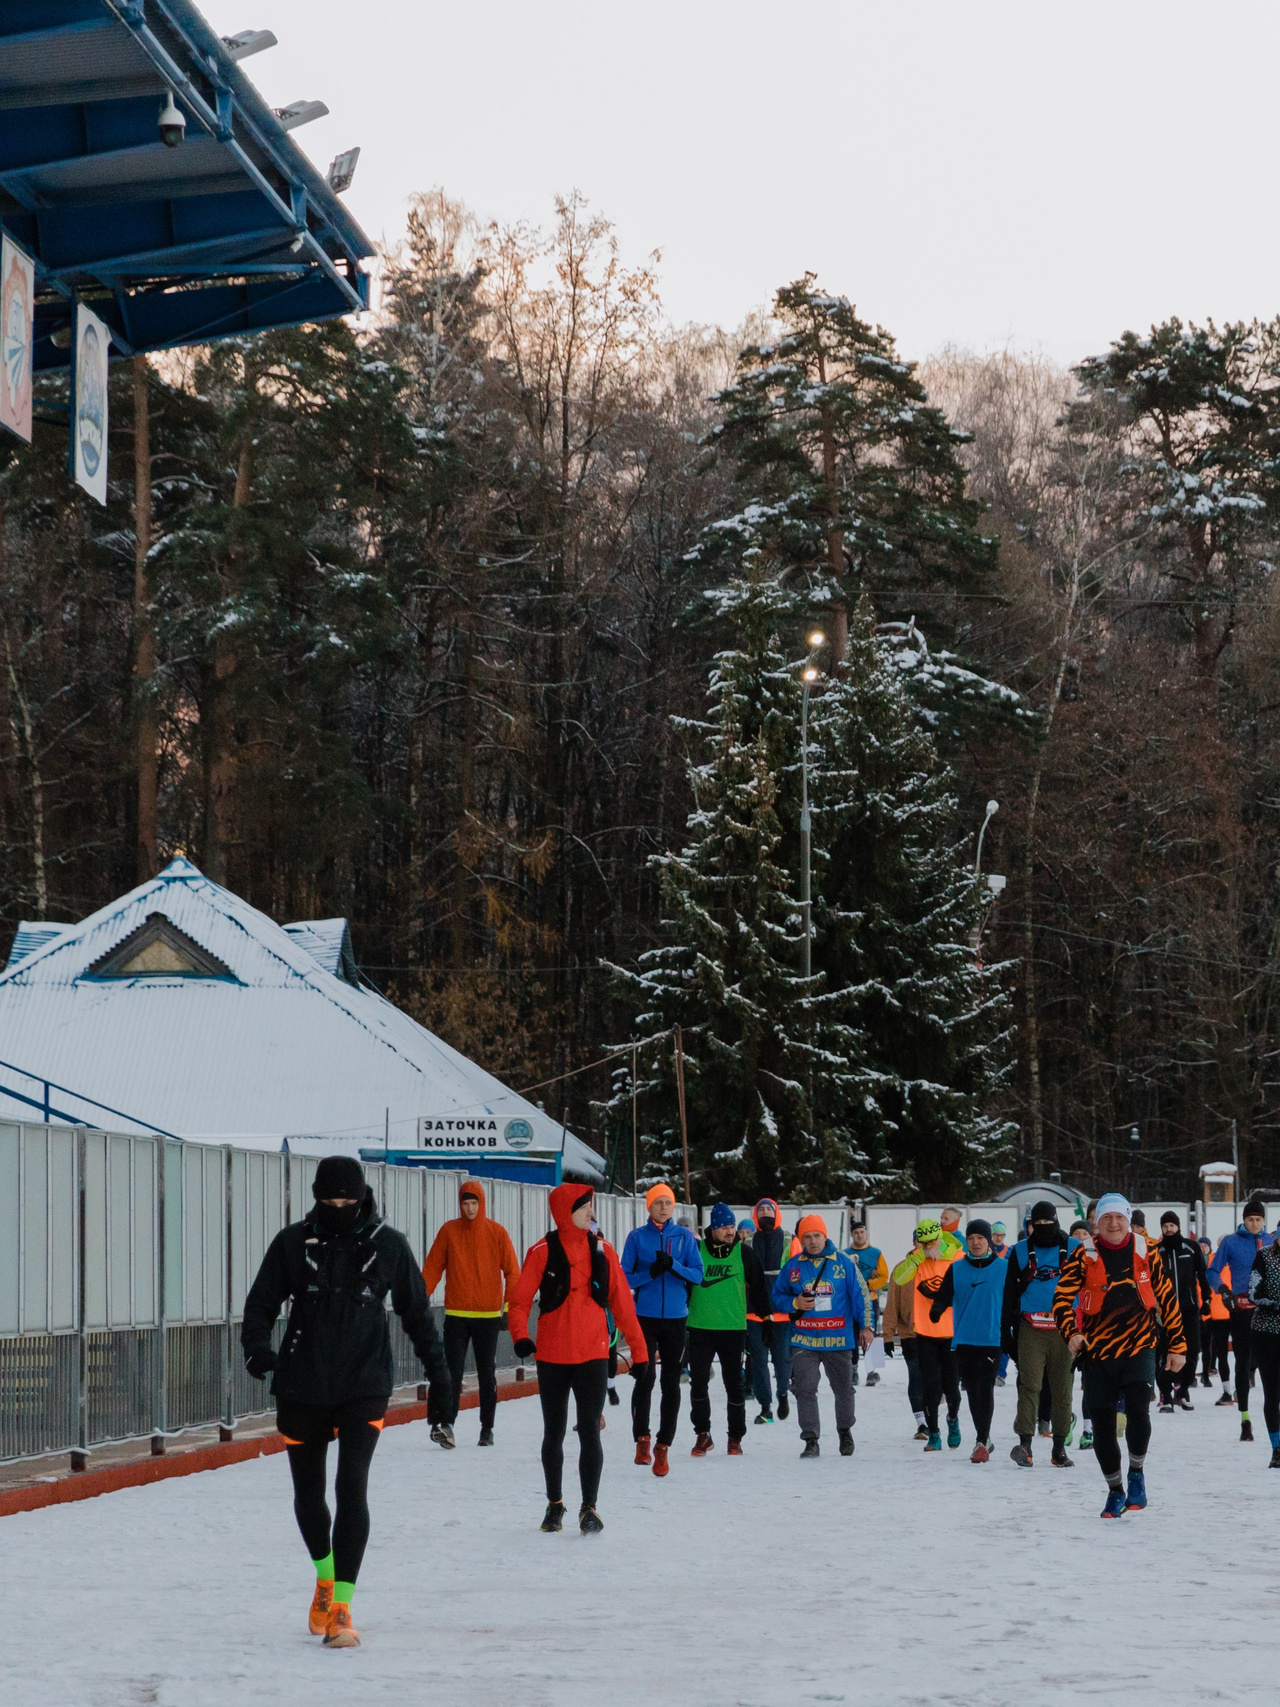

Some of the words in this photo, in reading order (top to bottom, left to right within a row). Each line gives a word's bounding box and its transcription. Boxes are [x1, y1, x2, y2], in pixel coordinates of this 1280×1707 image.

[424, 1120, 497, 1131] ЗАТОЧКА
[424, 1136, 497, 1147] КОНЬКОВ
[705, 1264, 732, 1277] NIKE
